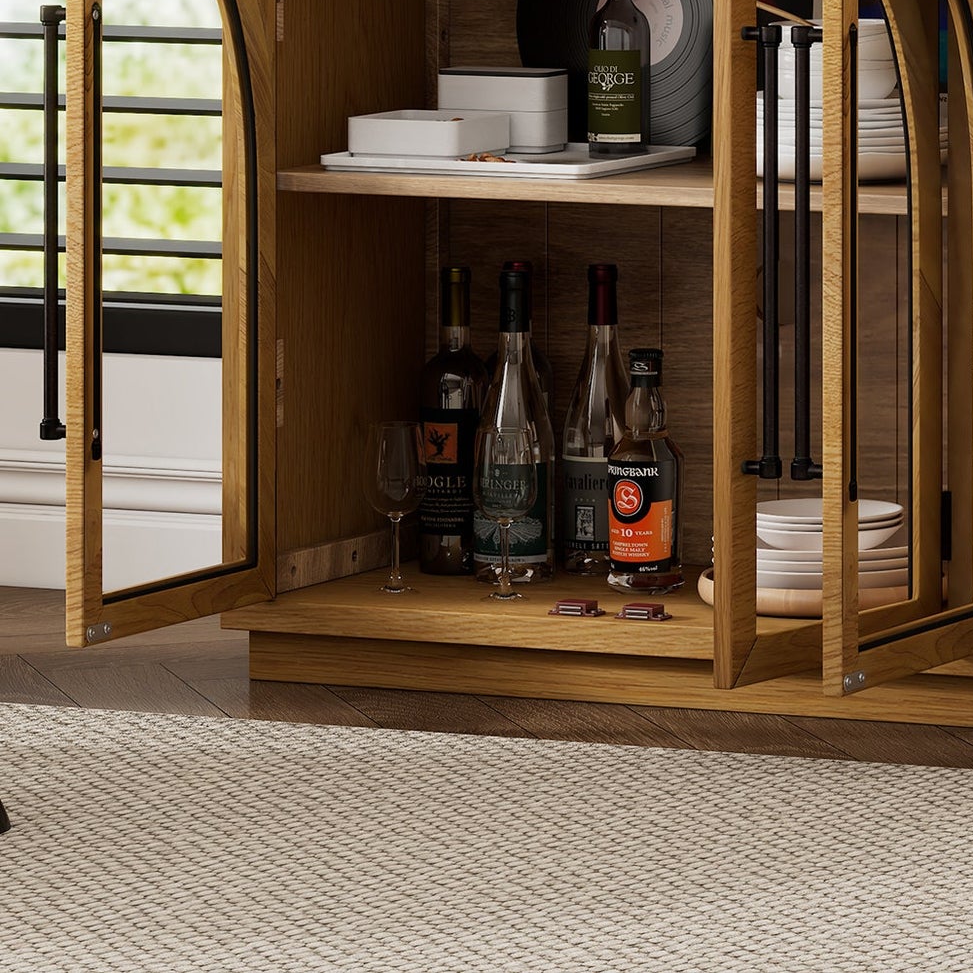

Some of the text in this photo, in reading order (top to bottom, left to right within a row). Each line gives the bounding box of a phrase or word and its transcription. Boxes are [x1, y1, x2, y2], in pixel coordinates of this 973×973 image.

[656, 14, 674, 46] music
[588, 72, 634, 84] GEORGE
[620, 528, 633, 537] 10
